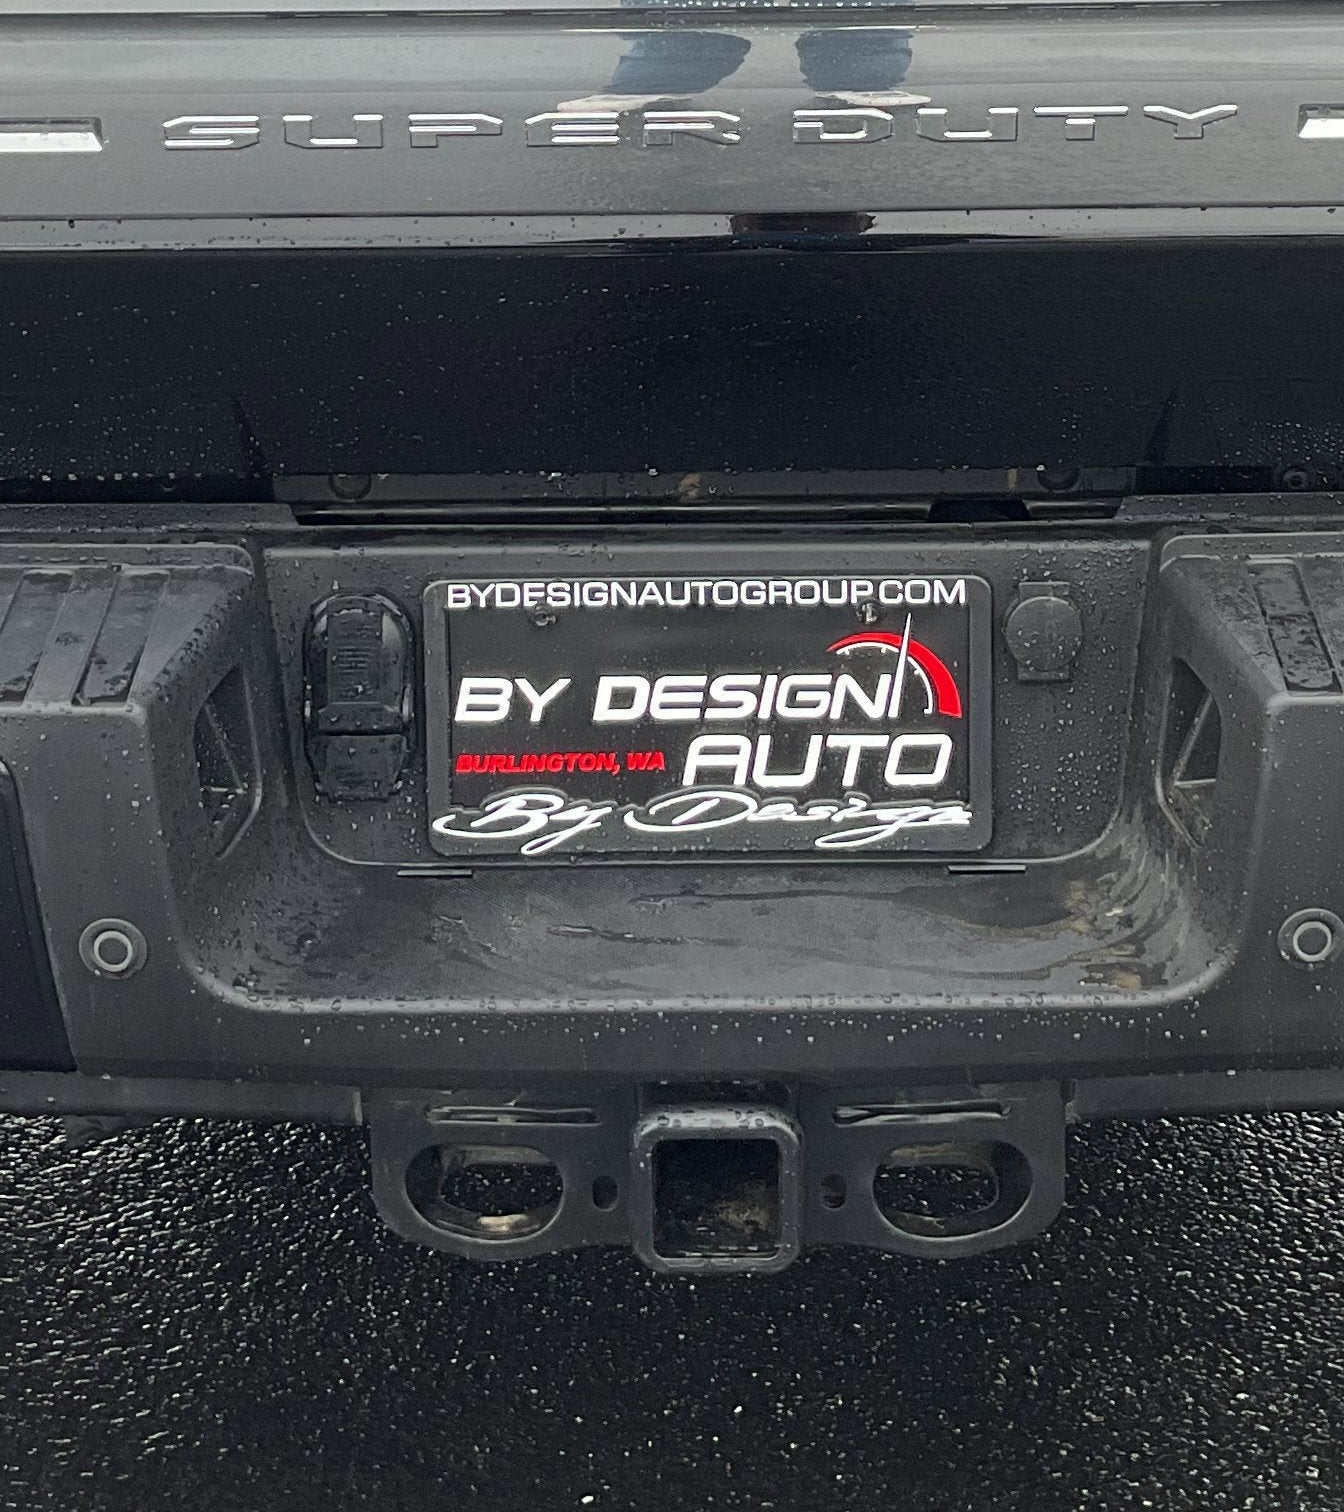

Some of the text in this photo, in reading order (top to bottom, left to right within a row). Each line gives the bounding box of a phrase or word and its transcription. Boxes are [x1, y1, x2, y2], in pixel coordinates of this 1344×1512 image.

[162, 104, 1240, 151] SUPER DUTY
[447, 578, 966, 609] BYDESIGNAUTOGROUPCOM
[455, 672, 894, 723] BY DESIGN
[455, 751, 666, 776] BURLINGTON, WA
[681, 732, 954, 789] AUTO
[431, 790, 974, 856] By Design
